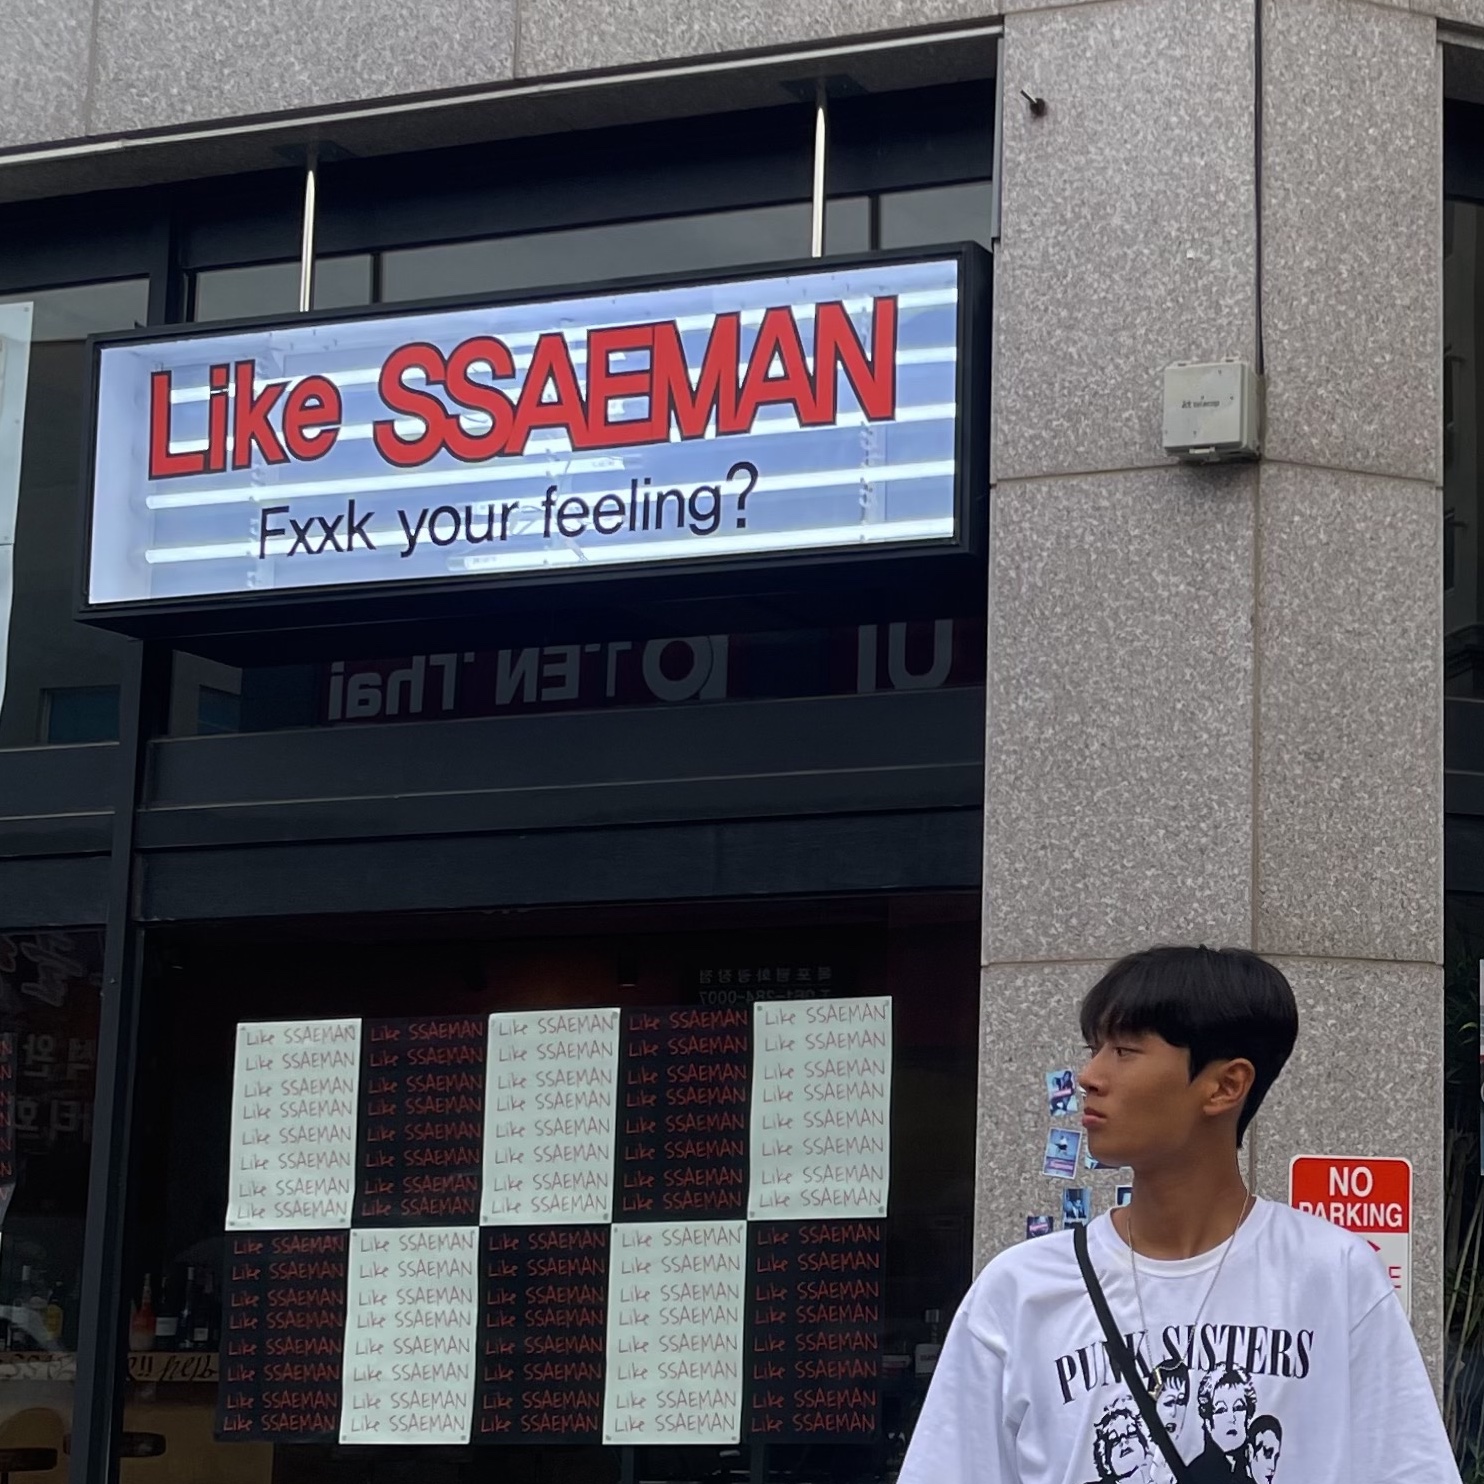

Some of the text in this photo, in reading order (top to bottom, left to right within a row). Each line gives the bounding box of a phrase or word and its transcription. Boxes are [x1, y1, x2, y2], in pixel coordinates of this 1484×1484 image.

[148, 296, 900, 480] Like SSAEMAN
[258, 461, 760, 560] Fxxk your feeling?
[498, 1013, 614, 1036] Like SSAEMAN
[629, 1009, 749, 1032] Like SSAEMAN
[765, 1003, 886, 1026] Like SSAEMAN
[246, 1024, 356, 1046] Like SSAEMAN
[370, 1020, 483, 1043] Like SSAEMAN
[764, 1029, 886, 1052] Like SSAEMAN
[245, 1050, 355, 1072] Like SSAEMAN
[498, 1040, 613, 1063] Like SSAEMAN
[497, 1067, 612, 1090] Like SSAEMAN
[764, 1057, 885, 1080] Like SSAEMAN
[244, 1076, 354, 1098] Like SSAEMAN
[763, 1080, 884, 1103] Like SSAEMAN
[242, 1098, 352, 1120] Like SSAEMAN
[496, 1090, 611, 1112] Like SSAEMAN
[495, 1116, 610, 1139] Like SSAEMAN
[762, 1107, 884, 1130] Like SSAEMAN
[241, 1124, 351, 1146] Like SSAEMAN
[761, 1135, 884, 1157] Like SSAEMAN
[240, 1150, 351, 1171] Like SSAEMAN
[494, 1143, 609, 1165] Like SSAEMAN
[493, 1170, 608, 1192] Like SSAEMAN
[761, 1163, 884, 1185] Like SSAEMAN
[1328, 1166, 1373, 1197] NO
[238, 1177, 350, 1198] Like SSAEMAN
[759, 1186, 882, 1208] Like SSAEMAN
[237, 1199, 348, 1221] Like SSAEMAN
[491, 1193, 607, 1215] Like SSAEMAN
[1299, 1201, 1403, 1228] PARKING
[360, 1231, 474, 1253] Like SSAEMAN
[621, 1226, 741, 1248] Like SSAEMAN
[359, 1258, 472, 1279] Like SSAEMAN
[621, 1253, 740, 1275] Like SSAEMAN
[358, 1286, 473, 1306] Like SSAEMAN
[620, 1281, 739, 1303] Like SSAEMAN
[356, 1309, 472, 1329] Like SSAEMAN
[618, 1305, 738, 1326] Like SSAEMAN
[355, 1335, 470, 1356] Like SSAEMAN
[618, 1332, 738, 1354] Like SSAEMAN
[1162, 1322, 1314, 1380] SISTERS
[353, 1362, 469, 1382] Like SSAEMAN
[617, 1360, 737, 1381] Like SSAEMAN
[352, 1390, 467, 1410] Like SSAEMAN
[616, 1388, 737, 1409] Like SSAEMAN
[350, 1413, 465, 1433] Like SSAEMAN
[614, 1412, 735, 1434] Like SSAEMAN
